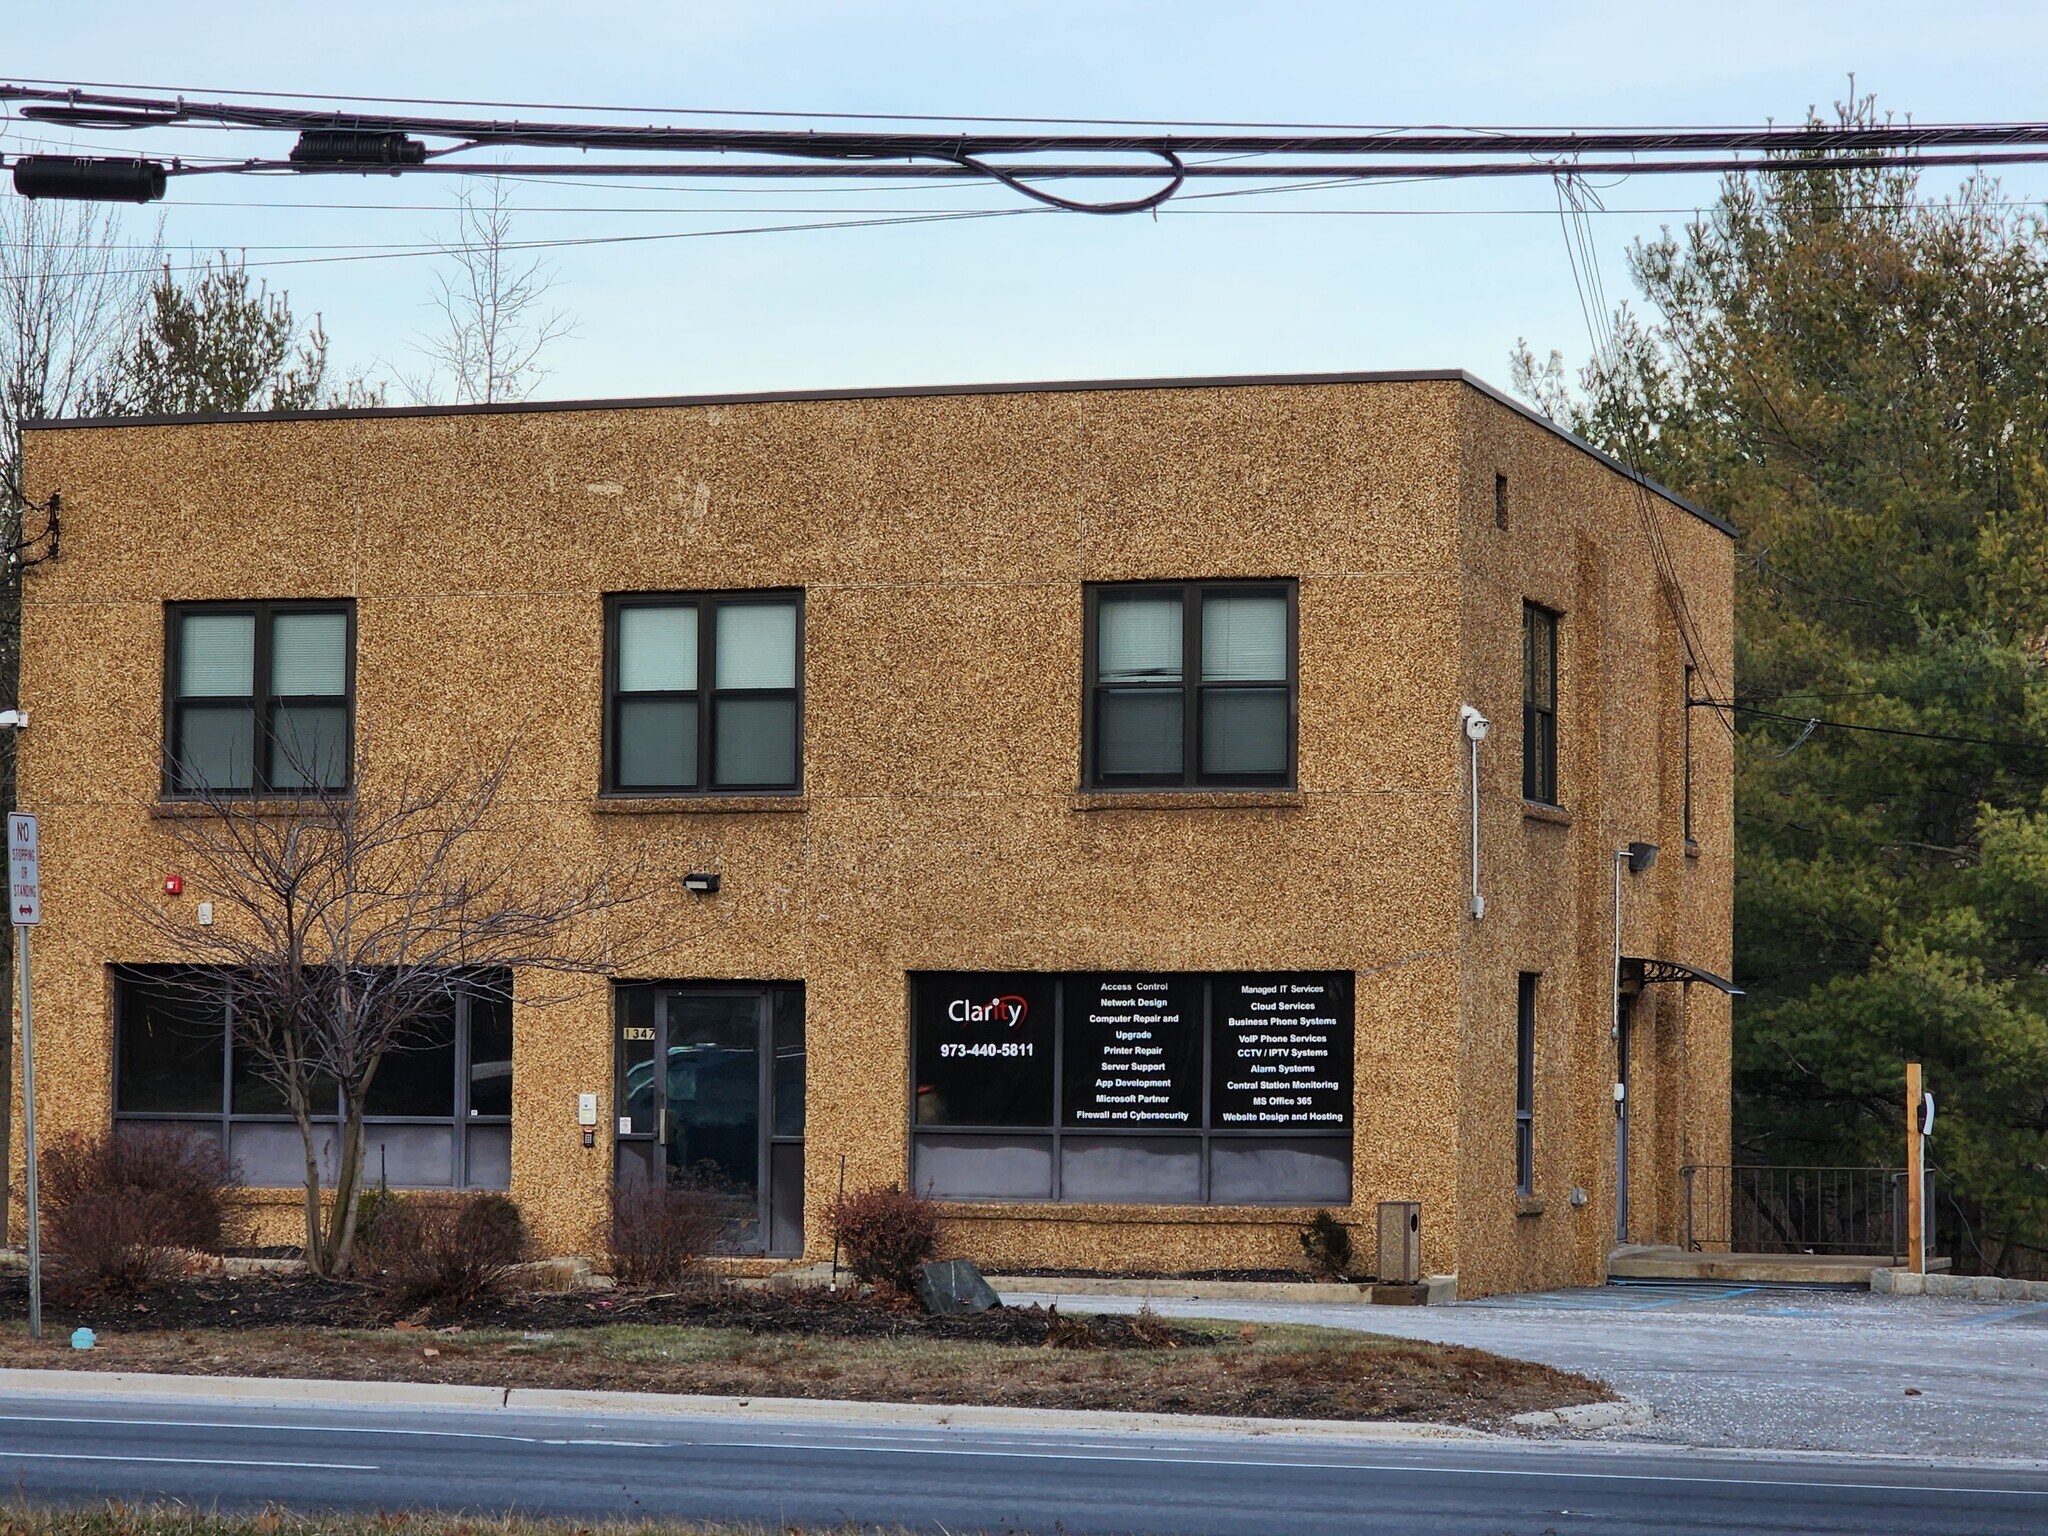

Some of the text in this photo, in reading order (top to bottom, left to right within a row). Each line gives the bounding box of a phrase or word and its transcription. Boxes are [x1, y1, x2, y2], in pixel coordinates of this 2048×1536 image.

[16, 822, 30, 842] NO
[12, 848, 36, 862] STOPPING
[21, 866, 28, 879] OR
[13, 884, 37, 898] STANDING
[1100, 982, 1168, 991] Access Control
[1241, 984, 1325, 995] Managed IT Services
[1100, 998, 1168, 1008] Network Design
[1250, 1001, 1316, 1011] Cloud Services
[948, 997, 1023, 1027] Clarity
[1089, 1014, 1179, 1024] Computer Repair and
[1228, 1017, 1337, 1028] Business Phone Systems
[626, 1028, 655, 1039] 1347
[1115, 1030, 1152, 1041] Upgrade
[1238, 1033, 1328, 1043] VoIP Phone Services
[940, 1043, 1034, 1057] 973-440-5811
[1103, 1046, 1163, 1056] Printer Repair
[1237, 1048, 1329, 1059] CCTV / IPTV Systems
[1101, 1062, 1166, 1072] Server Support
[1250, 1064, 1316, 1075] Alarm Systems
[1095, 1079, 1172, 1089] App Development
[1226, 1080, 1339, 1091] Central Station Monitoring
[1096, 1094, 1170, 1103] Microsoft Partner
[1252, 1096, 1313, 1106] MS Office 365
[1076, 1110, 1189, 1121] Firewall and Cybersecurity
[1222, 1111, 1344, 1123] Website Design and Hosting
